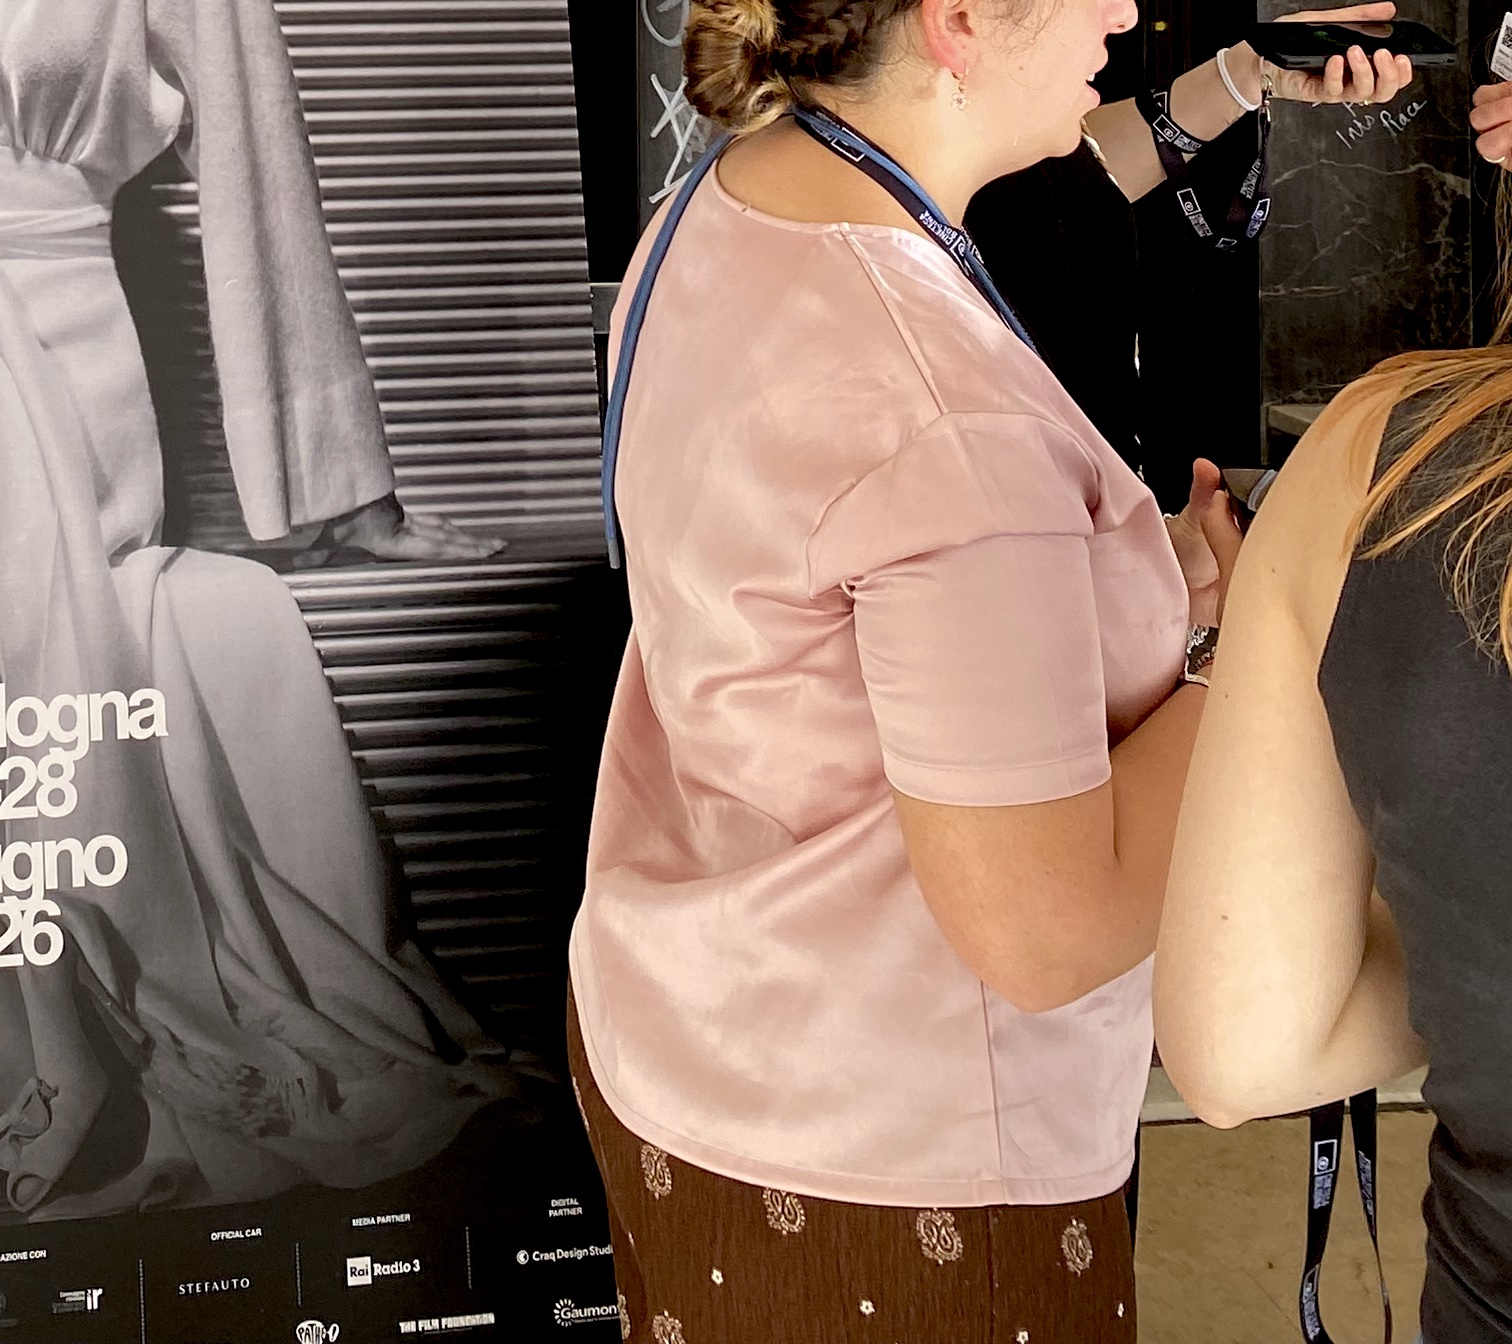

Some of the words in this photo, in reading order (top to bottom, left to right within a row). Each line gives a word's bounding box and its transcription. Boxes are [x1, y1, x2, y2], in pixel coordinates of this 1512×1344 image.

[376, 1213, 410, 1224] PARTNER
[549, 1207, 582, 1217] PARTNER
[210, 1230, 244, 1241] OFFICIAL
[245, 1228, 262, 1237] CAR
[29, 1250, 47, 1259] CON
[556, 1247, 588, 1260] Design
[350, 1264, 369, 1277] Rai
[373, 1261, 411, 1276] Radio
[413, 1259, 421, 1272] 3
[178, 1277, 250, 1295] STEFAUTO
